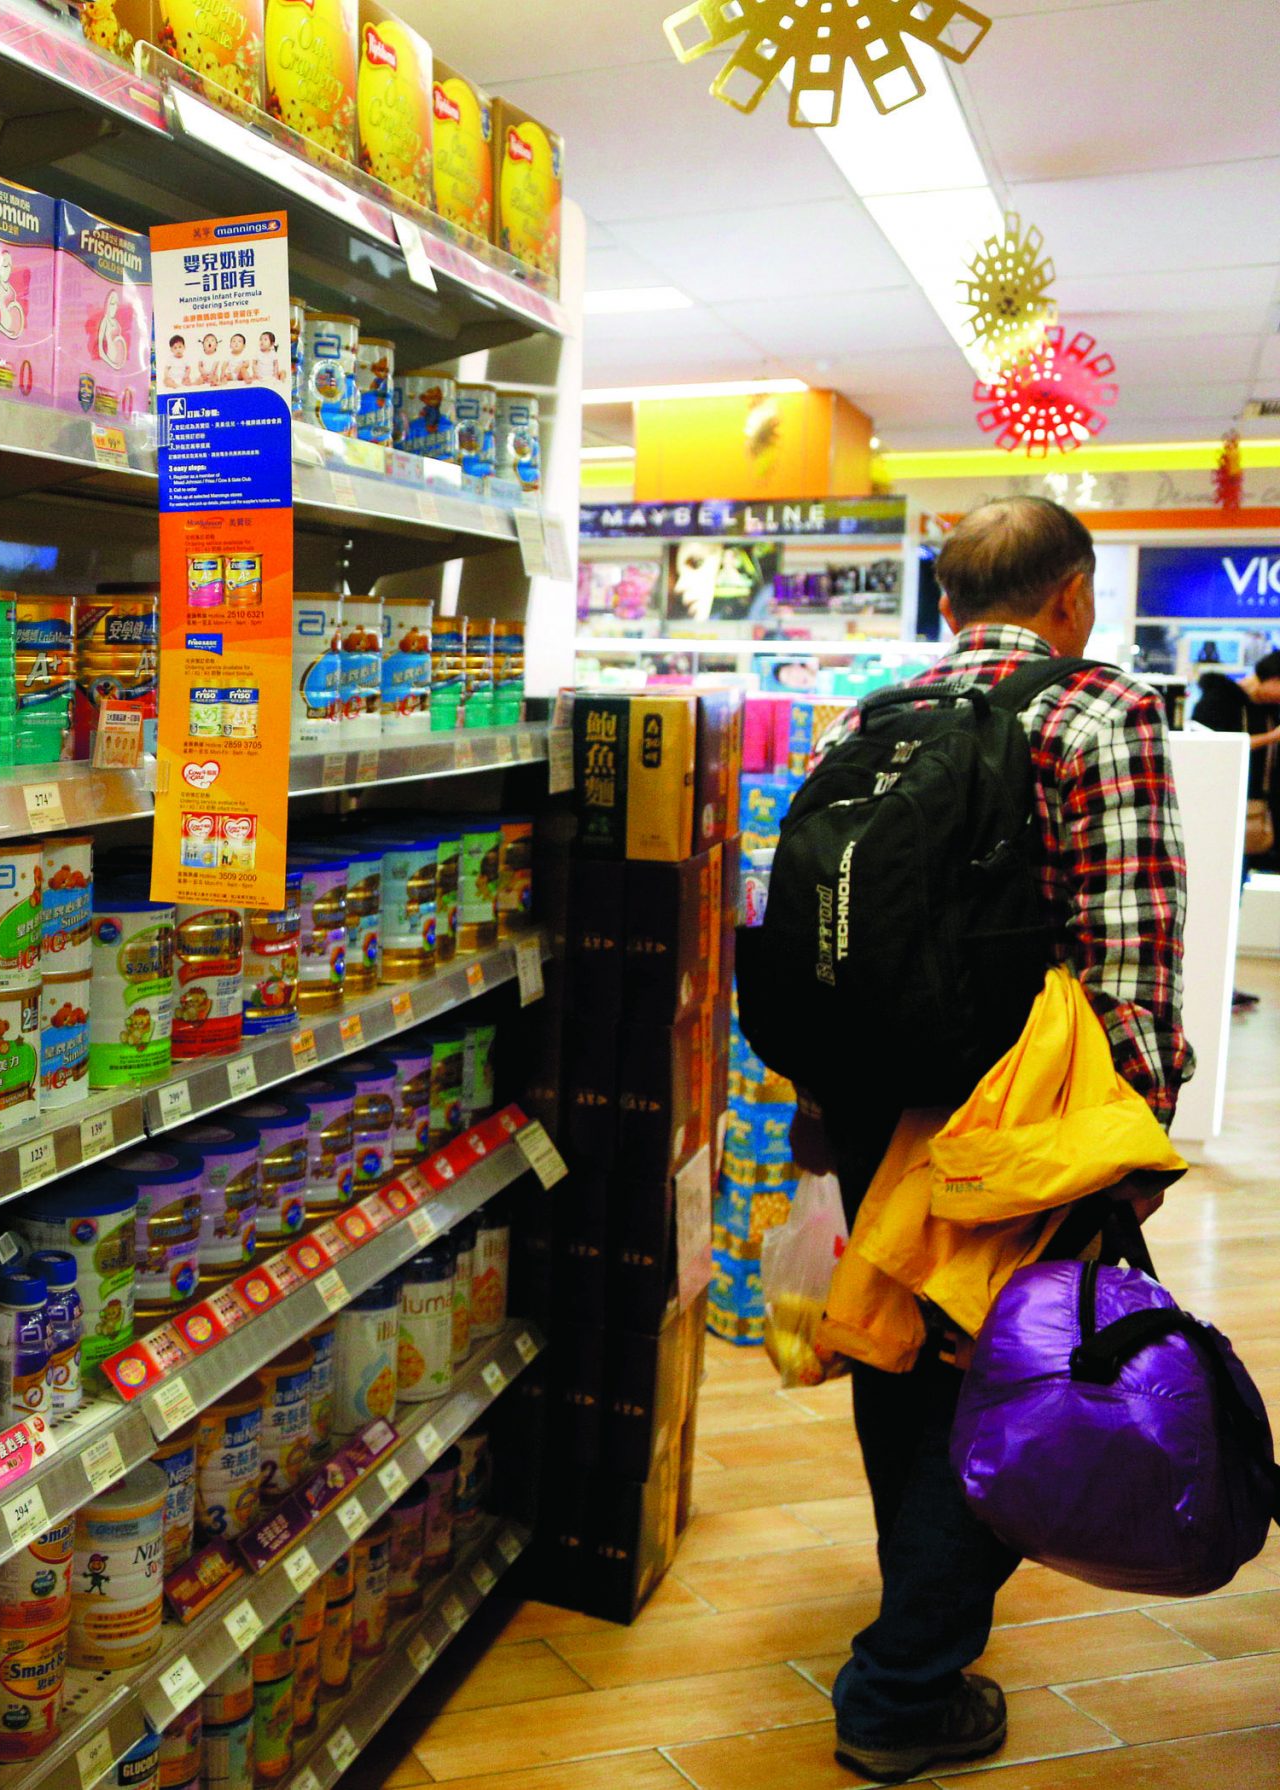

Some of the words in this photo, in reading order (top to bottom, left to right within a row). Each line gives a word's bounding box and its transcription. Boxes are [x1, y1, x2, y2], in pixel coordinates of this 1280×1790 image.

[217, 223, 267, 236] mannings
[184, 249, 255, 274] 嬰兒奶粉
[185, 270, 255, 292] 一訂即有
[179, 295, 211, 304] Mannings
[212, 293, 232, 301] Infant
[234, 290, 262, 299] Formula
[192, 302, 222, 311] Ordering
[224, 299, 249, 307] Service
[601, 503, 826, 528] MAYBELLINE
[836, 840, 857, 961] TECHNOLOGY
[10, 1659, 55, 1680] Smart
